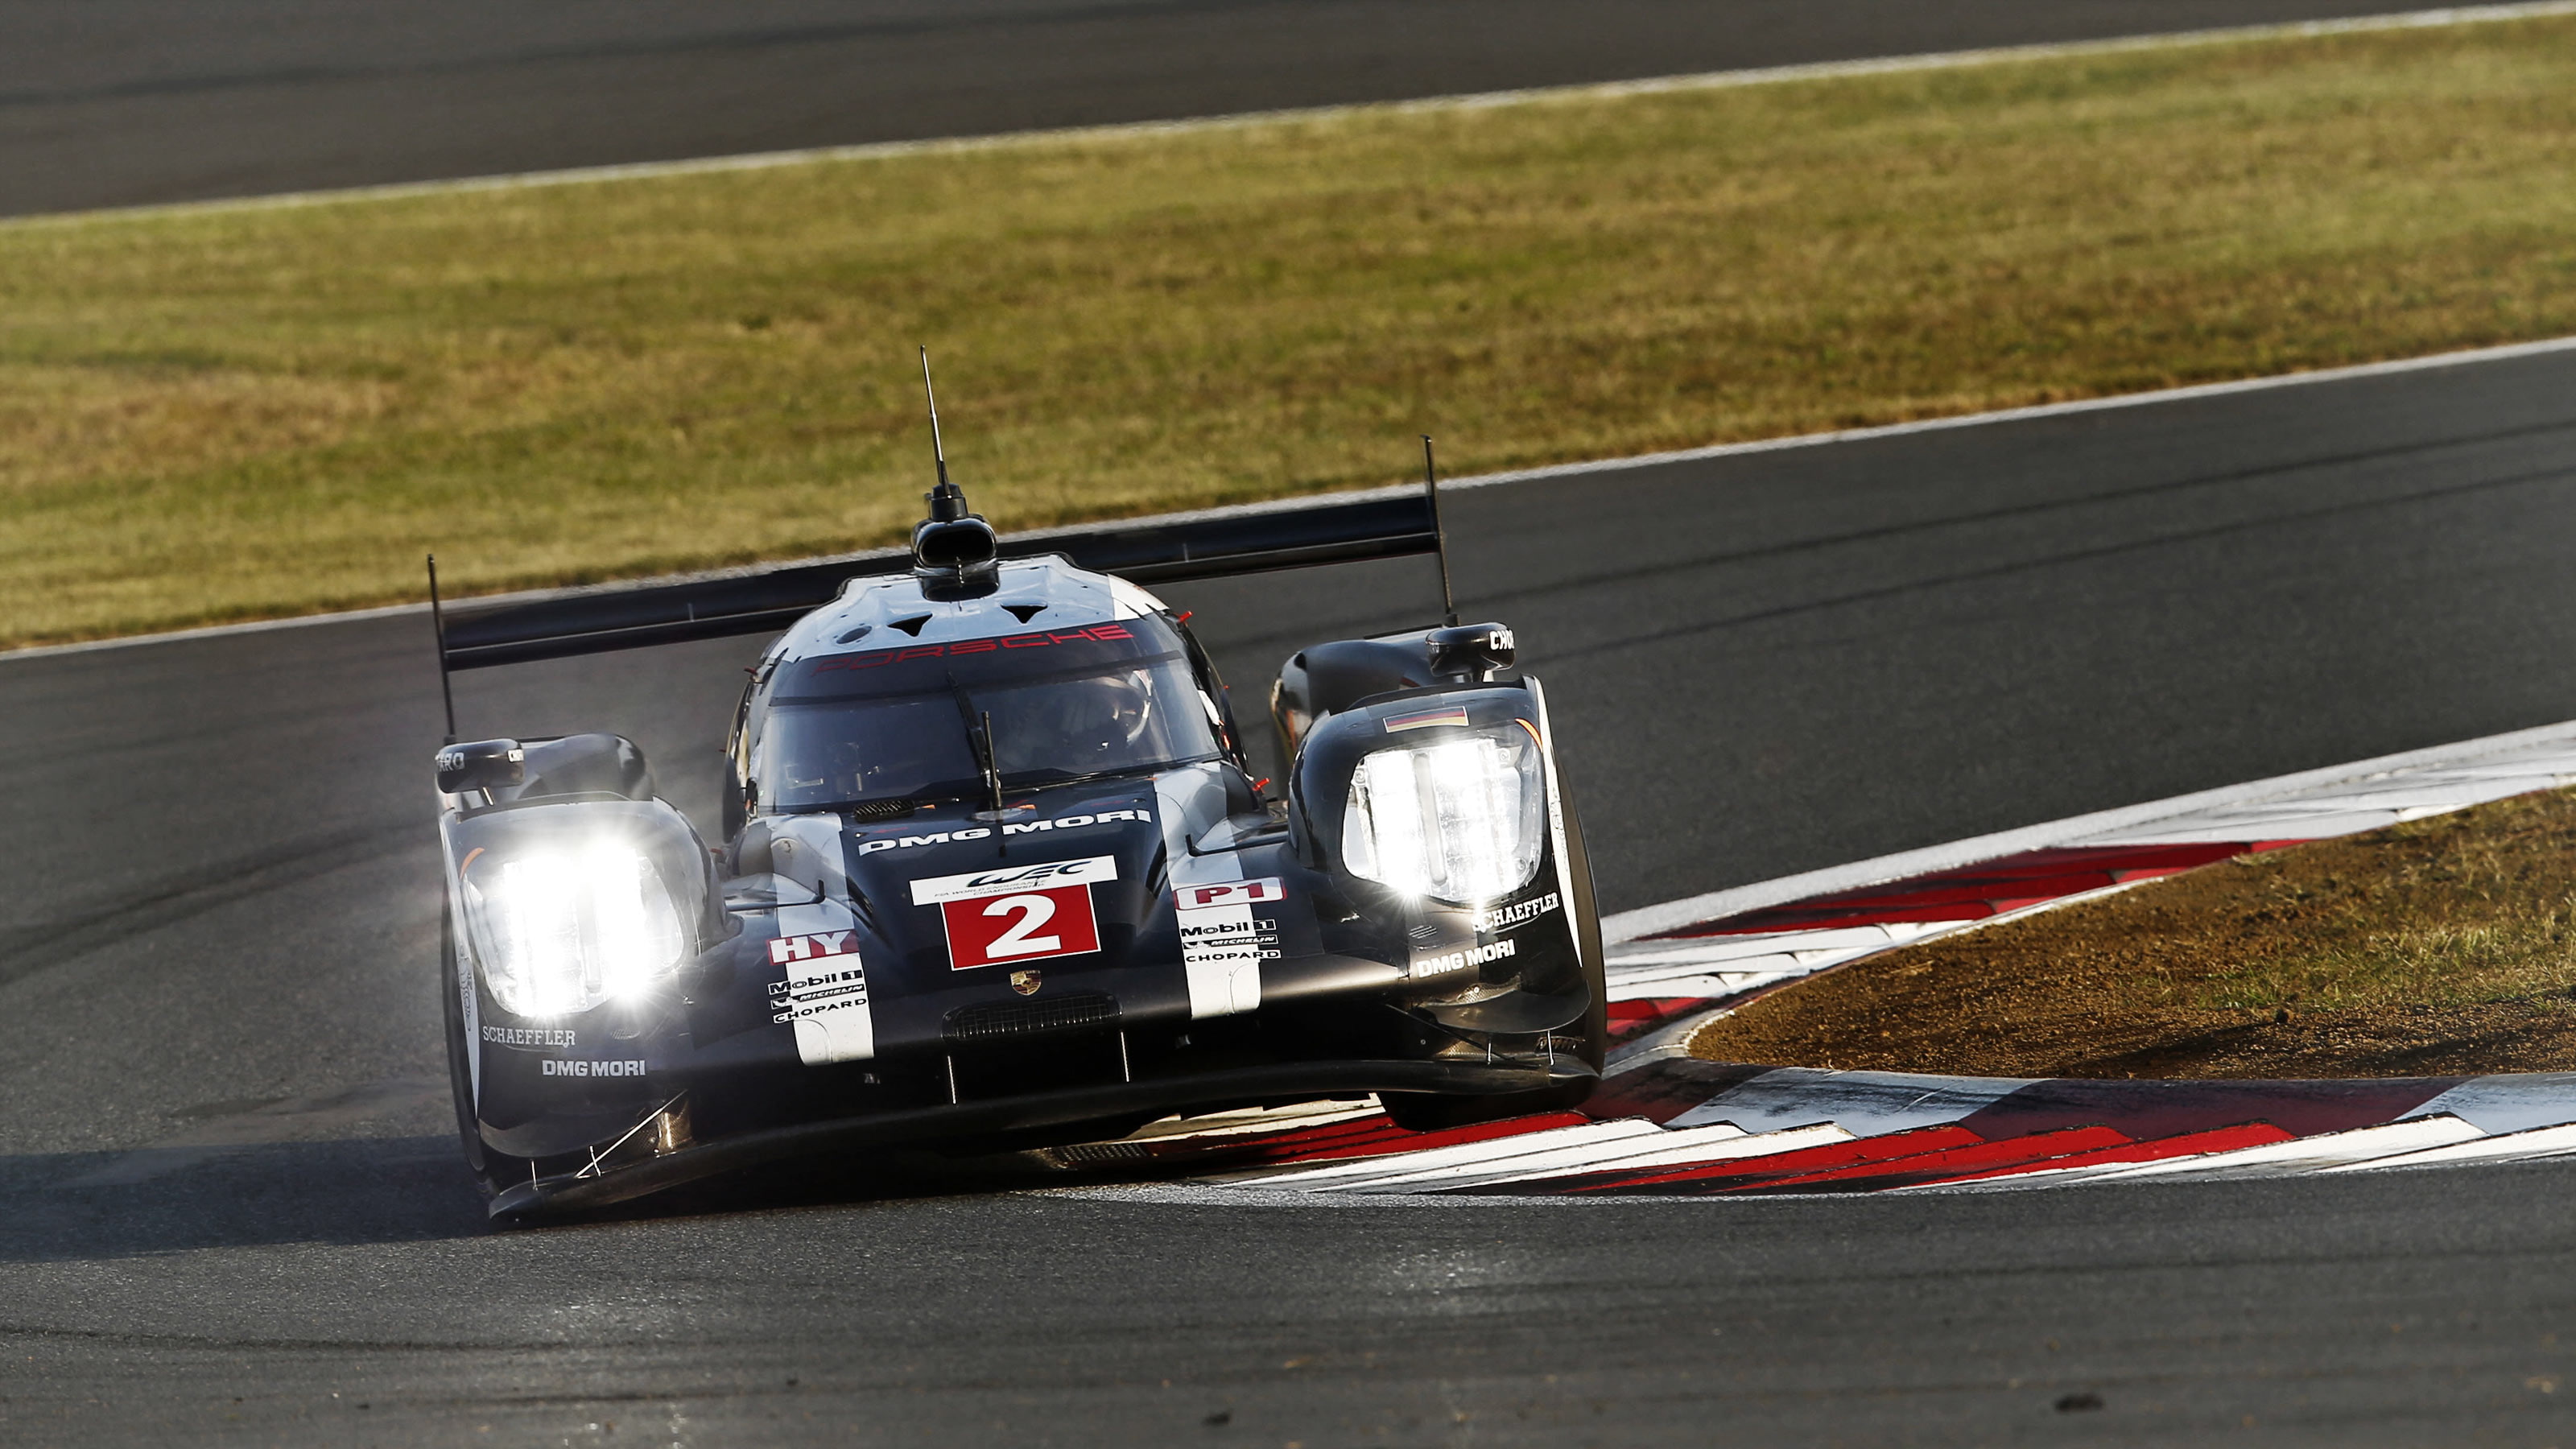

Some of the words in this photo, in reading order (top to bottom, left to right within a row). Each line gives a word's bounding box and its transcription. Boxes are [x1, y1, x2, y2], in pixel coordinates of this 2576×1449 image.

[810, 624, 1134, 678] PORSCHE
[858, 827, 992, 857] DMG
[1002, 809, 1152, 836] MORI
[966, 861, 1092, 887] WEC
[1195, 882, 1265, 904] P1
[1472, 892, 1559, 932] SCHAEFFLER
[981, 894, 1062, 959] 2
[1180, 922, 1249, 937] Mobil
[769, 931, 851, 964] HY
[1211, 936, 1275, 947] MICHELIN
[1186, 952, 1279, 962] CHOPARD
[1417, 952, 1465, 978] DMG
[1464, 939, 1517, 967] MORI
[769, 973, 837, 994] Mobil
[799, 985, 863, 1001] MICHELIN
[774, 998, 868, 1022] CHOPARD
[483, 1026, 576, 1047] SCHAEFFLER
[542, 1059, 588, 1077] DMG
[591, 1059, 646, 1077] MORI
